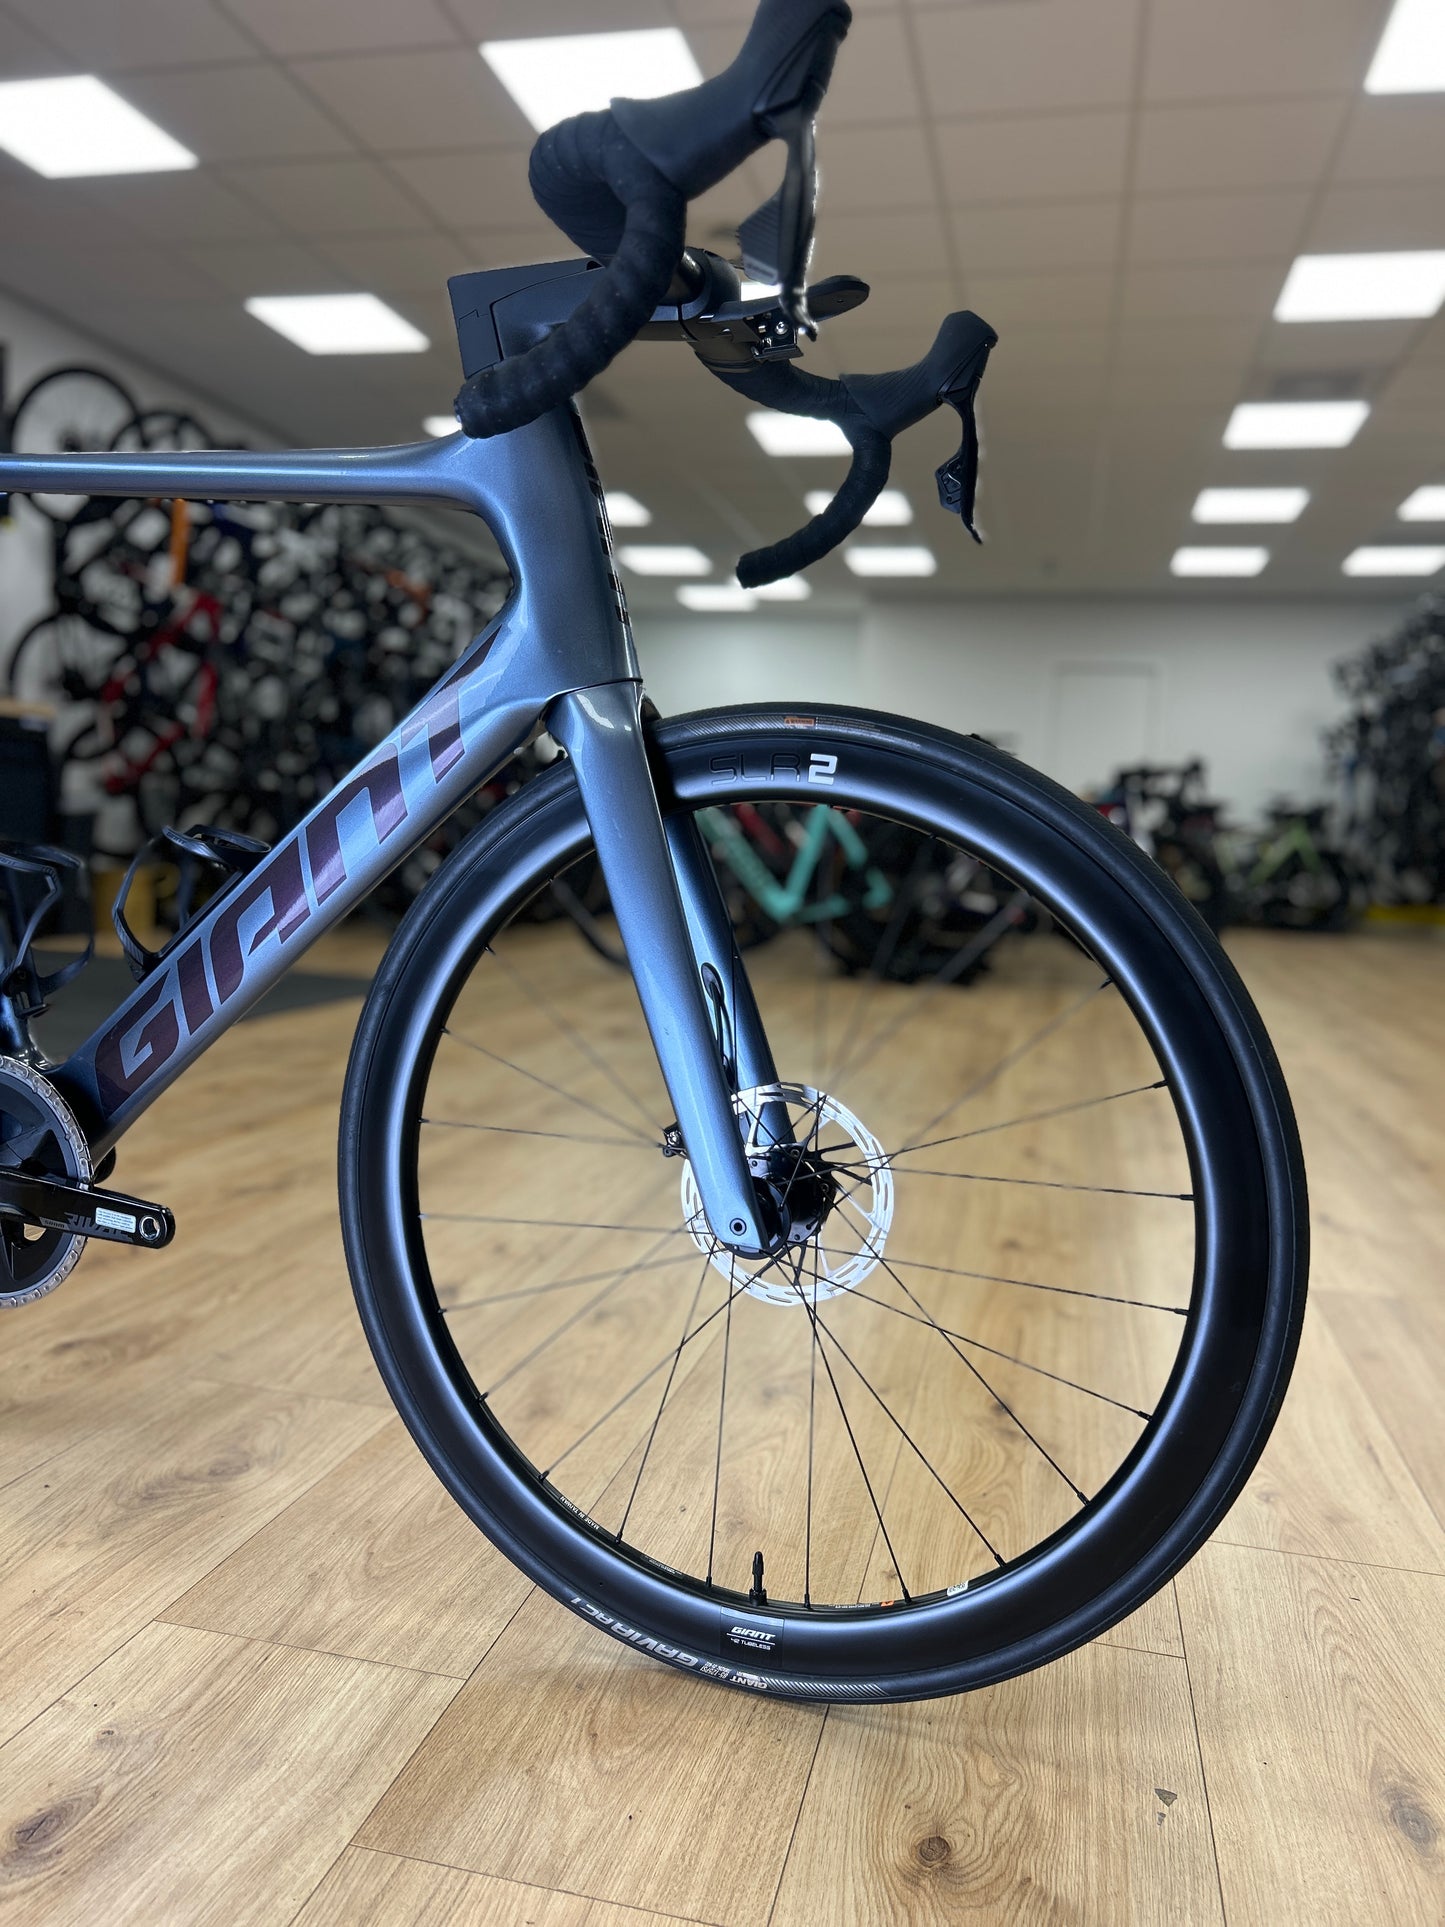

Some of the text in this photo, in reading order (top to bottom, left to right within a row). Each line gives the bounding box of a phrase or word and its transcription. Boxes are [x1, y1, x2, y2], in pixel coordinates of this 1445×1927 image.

[94, 625, 502, 1120] GIANT
[560, 1496, 579, 1514] TAIWAN
[584, 1517, 600, 1530] MADE
[578, 1604, 614, 1625] AC
[731, 1626, 776, 1640] GIANT
[611, 1622, 699, 1667] GAVIA
[741, 1640, 771, 1651] TUBELESS
[730, 1675, 768, 1689] GIANT
